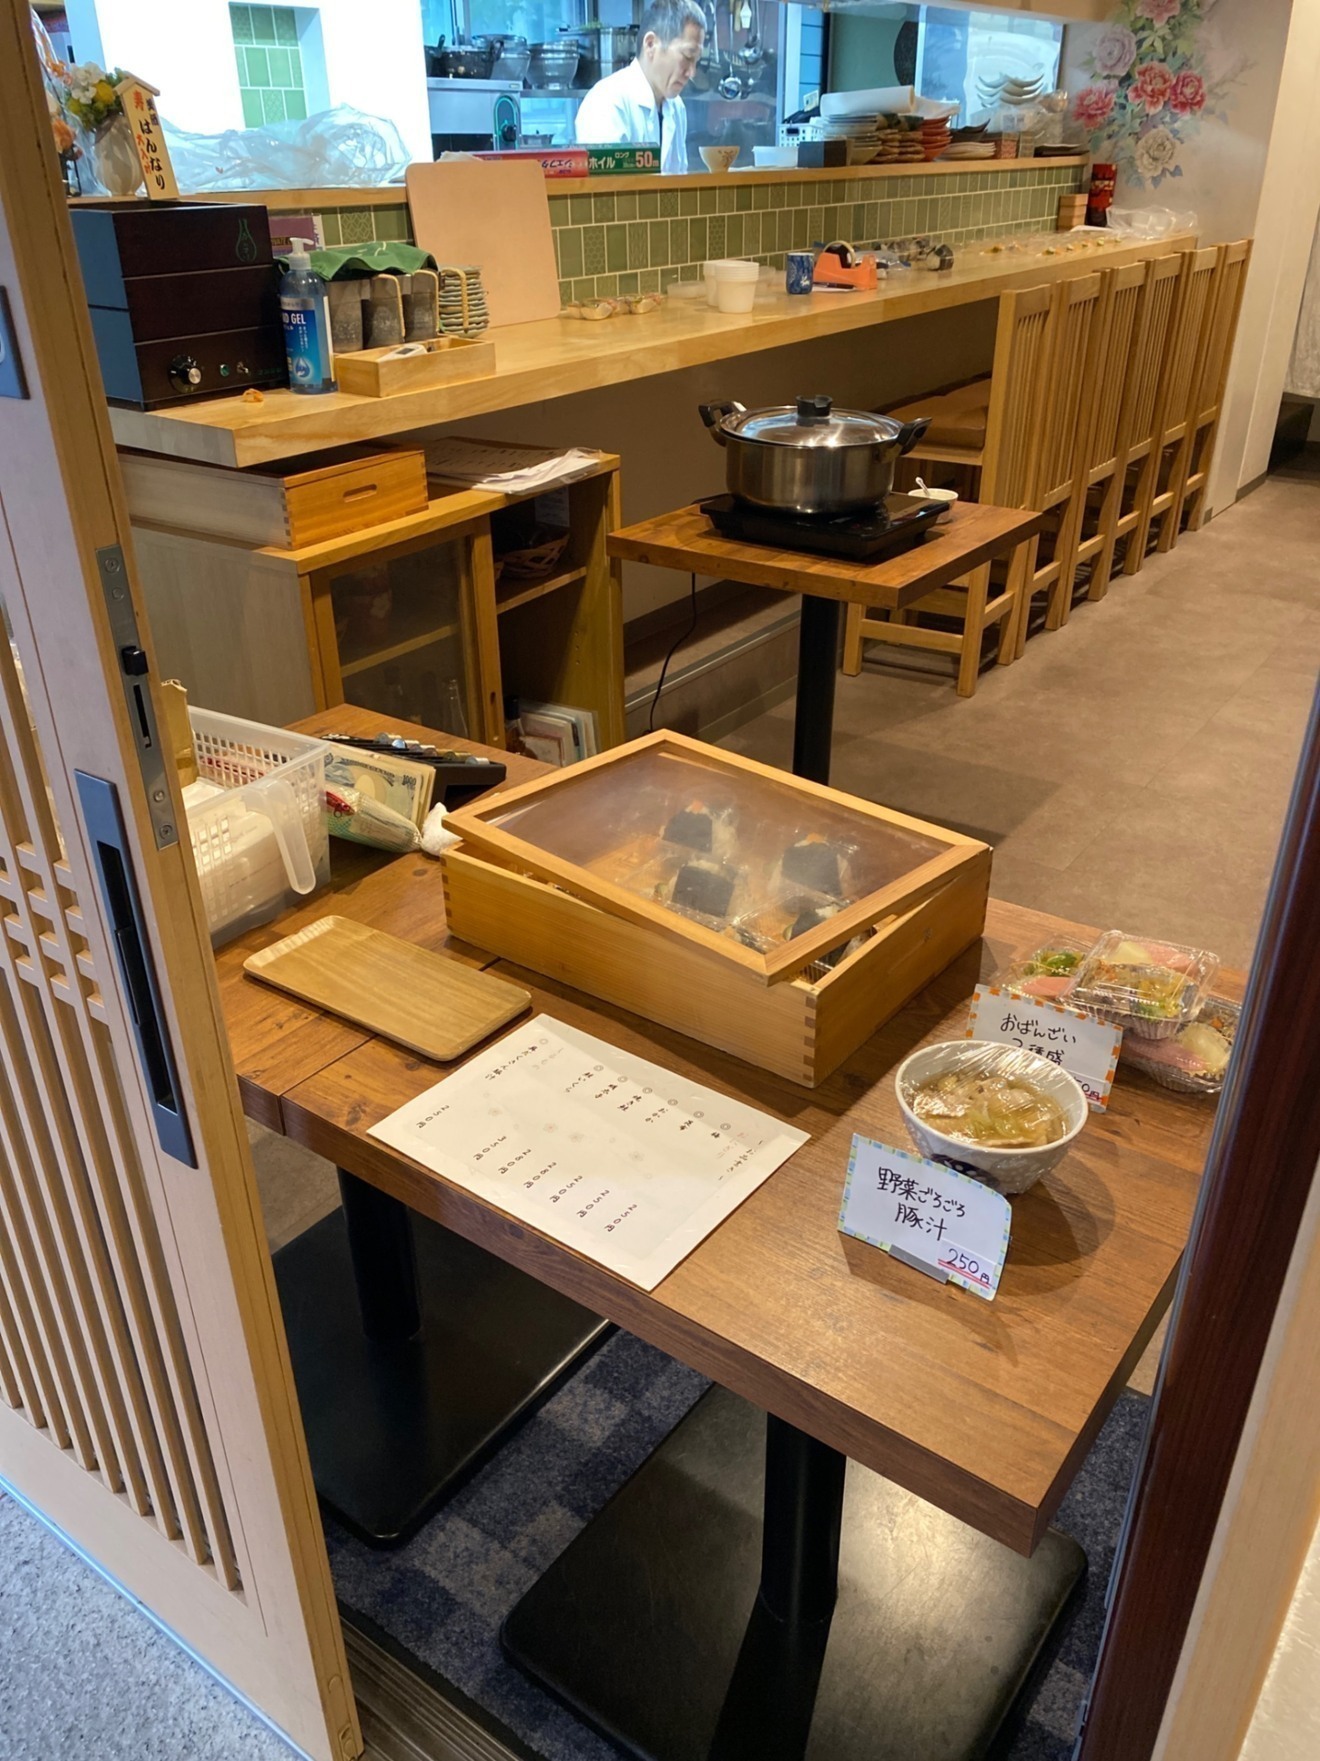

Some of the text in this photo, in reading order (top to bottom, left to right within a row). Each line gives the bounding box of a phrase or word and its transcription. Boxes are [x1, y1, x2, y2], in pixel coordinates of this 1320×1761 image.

[138, 118, 165, 190] はんなり
[291, 313, 306, 325] GEL
[1000, 1012, 1077, 1044] おばんざい
[416, 1104, 450, 1128] 250円
[473, 1135, 507, 1161] 350円
[498, 1148, 532, 1175] 280円
[523, 1161, 557, 1189] 280円
[549, 1175, 583, 1203] 250円
[576, 1189, 610, 1218] 250円
[877, 1166, 966, 1218] 野菜ごろごろ
[604, 1203, 638, 1232] 250円
[894, 1202, 948, 1241] 豚汁
[946, 1248, 992, 1286] 250円
